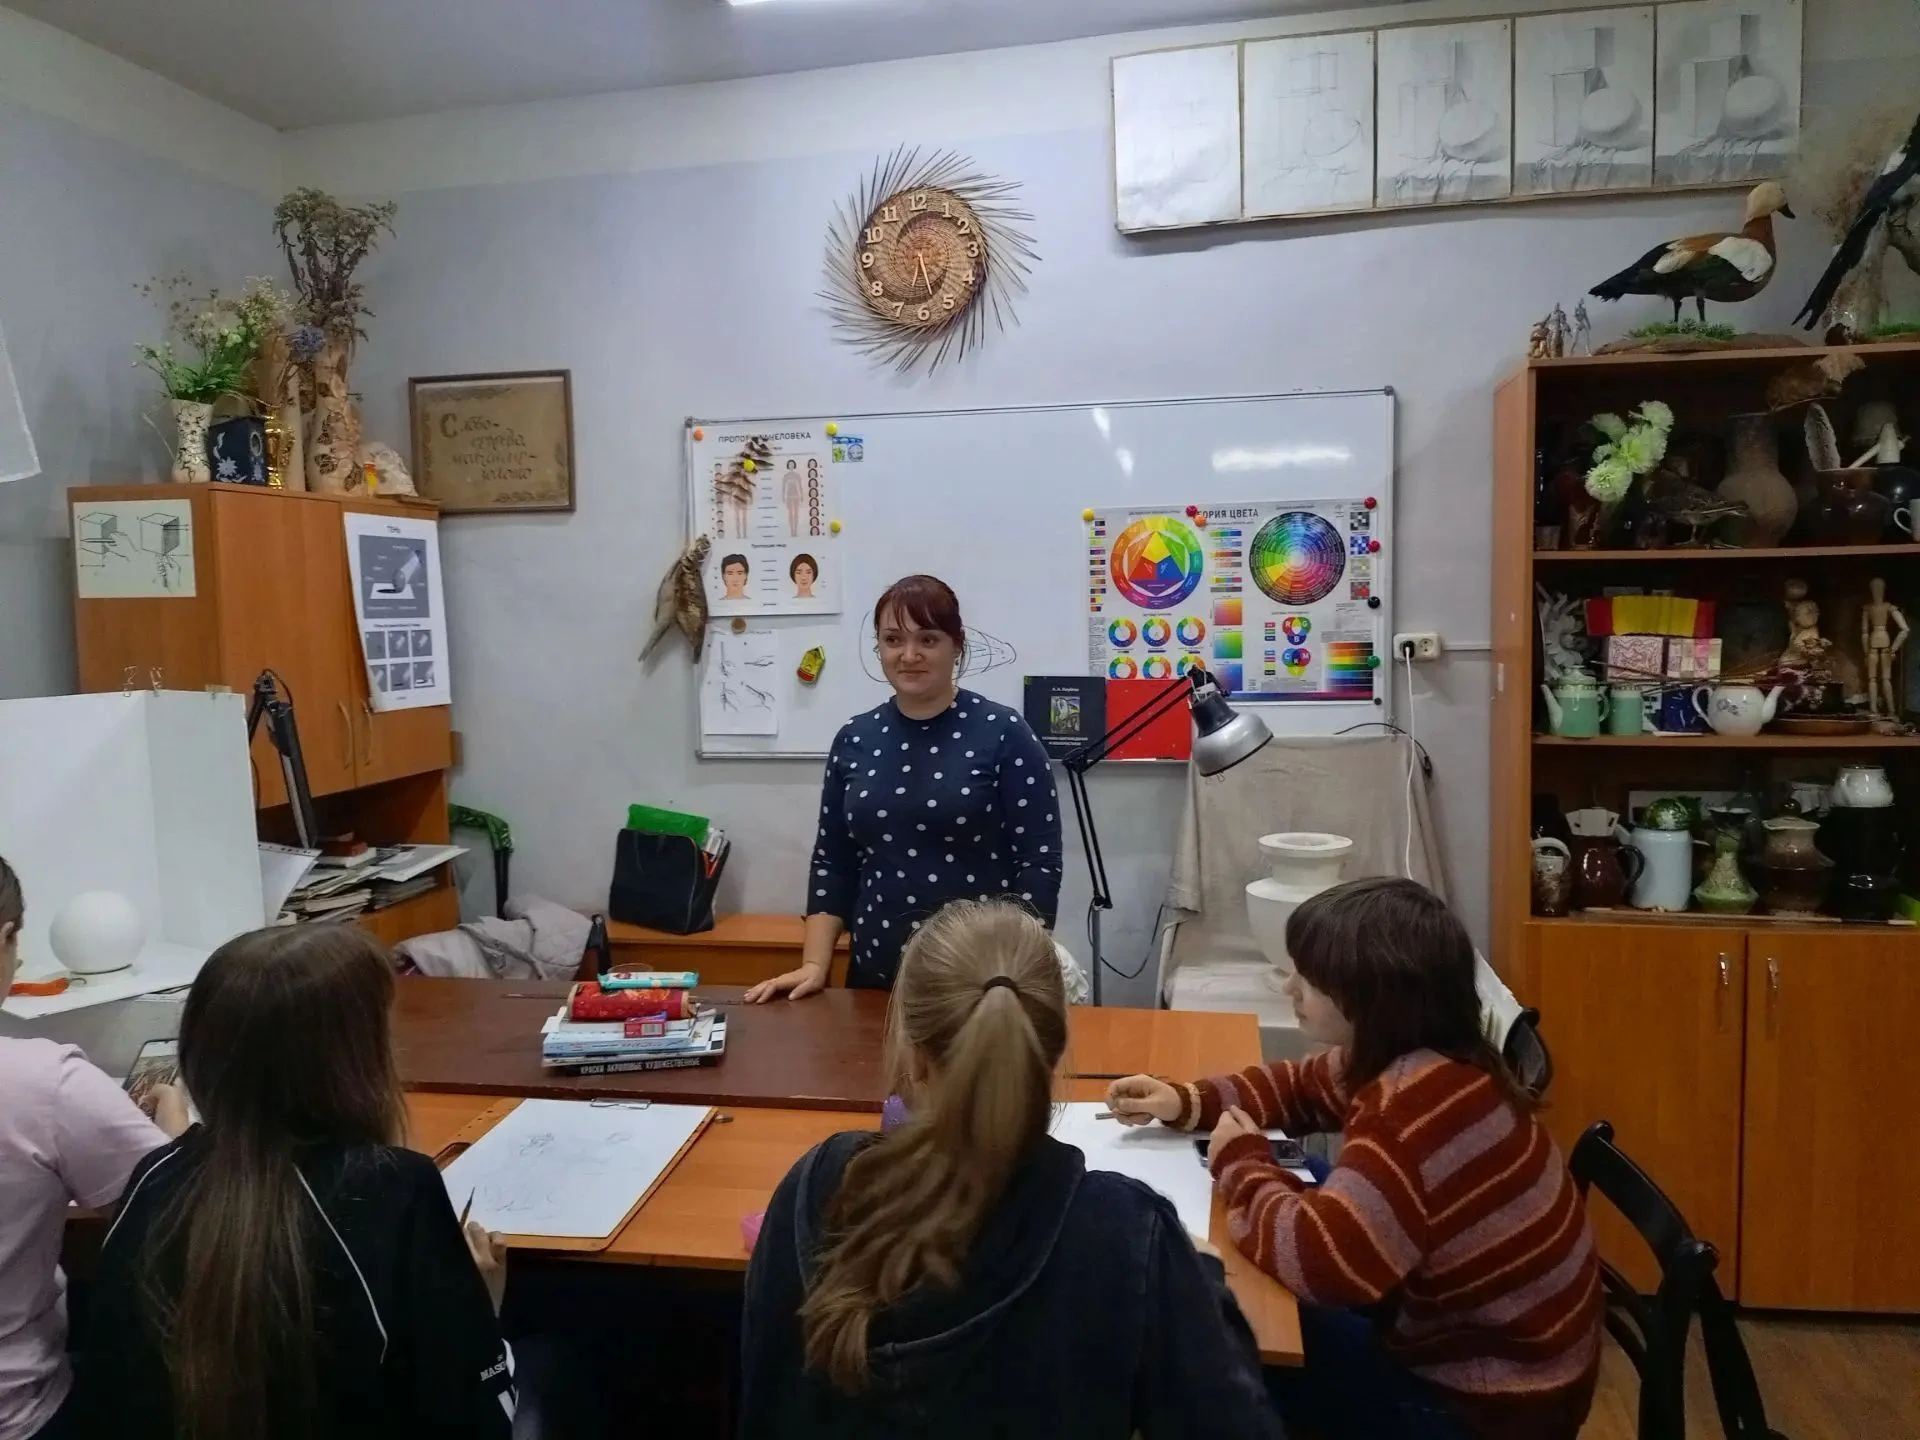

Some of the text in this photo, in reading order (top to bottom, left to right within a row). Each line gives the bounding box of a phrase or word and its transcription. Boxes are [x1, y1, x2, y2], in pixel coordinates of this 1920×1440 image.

[908, 194, 928, 211] 12
[942, 201, 952, 218] 1
[881, 205, 900, 222] 11
[864, 226, 884, 244] 10
[957, 219, 971, 235] 2
[966, 241, 979, 258] 3
[861, 252, 875, 269] 9
[962, 270, 975, 286] 4
[870, 281, 884, 297] 8
[892, 302, 905, 318] 7
[942, 294, 955, 310] 5
[917, 306, 930, 321] 6
[1197, 508, 1259, 519] ОРИЯ ЦВЕТА
[580, 1065, 604, 1075] КРАСКИ
